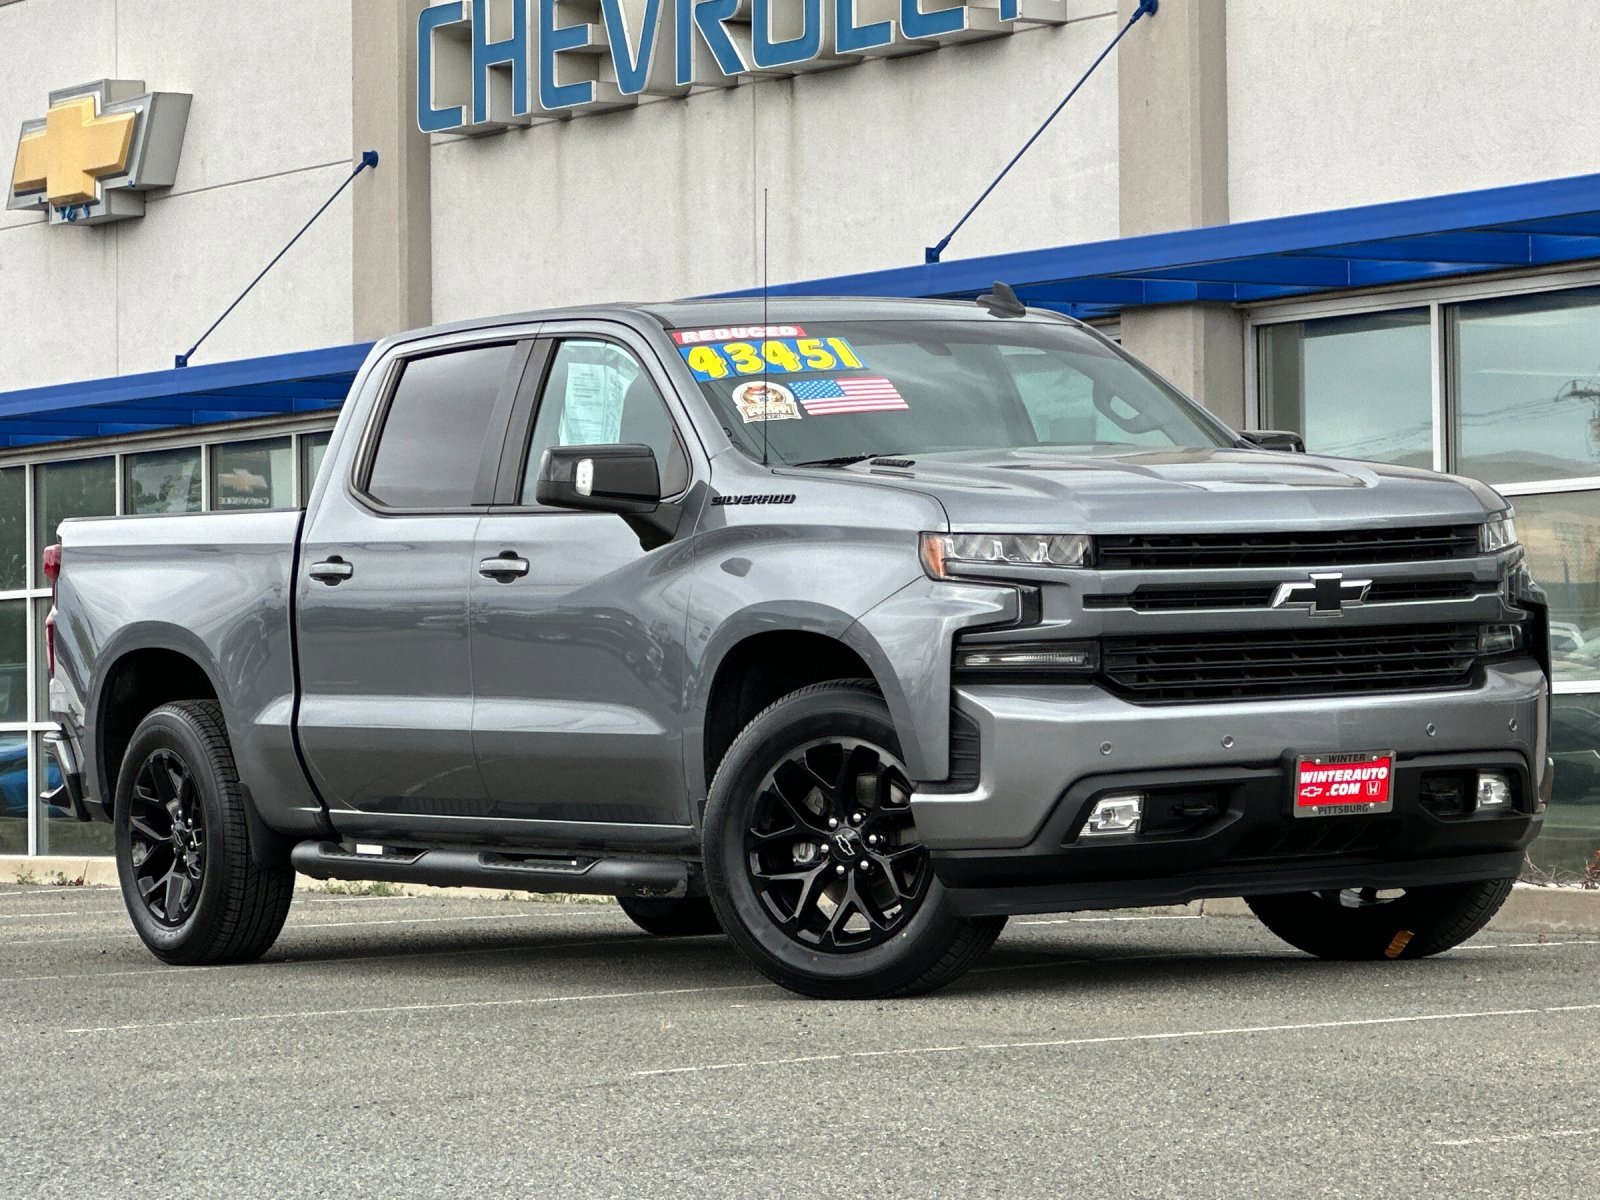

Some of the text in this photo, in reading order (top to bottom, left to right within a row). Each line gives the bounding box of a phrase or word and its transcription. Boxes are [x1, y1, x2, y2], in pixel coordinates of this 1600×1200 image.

[417, 0, 1022, 133] CHEVROL
[681, 325, 798, 342] REDUCED
[688, 337, 862, 379] 43451
[710, 493, 797, 506] SILVERADO
[1328, 753, 1366, 763] WINTER
[1300, 767, 1388, 784] WINTERAUTO
[1325, 782, 1361, 796] .COM
[1318, 804, 1368, 814] PITTSBURG
